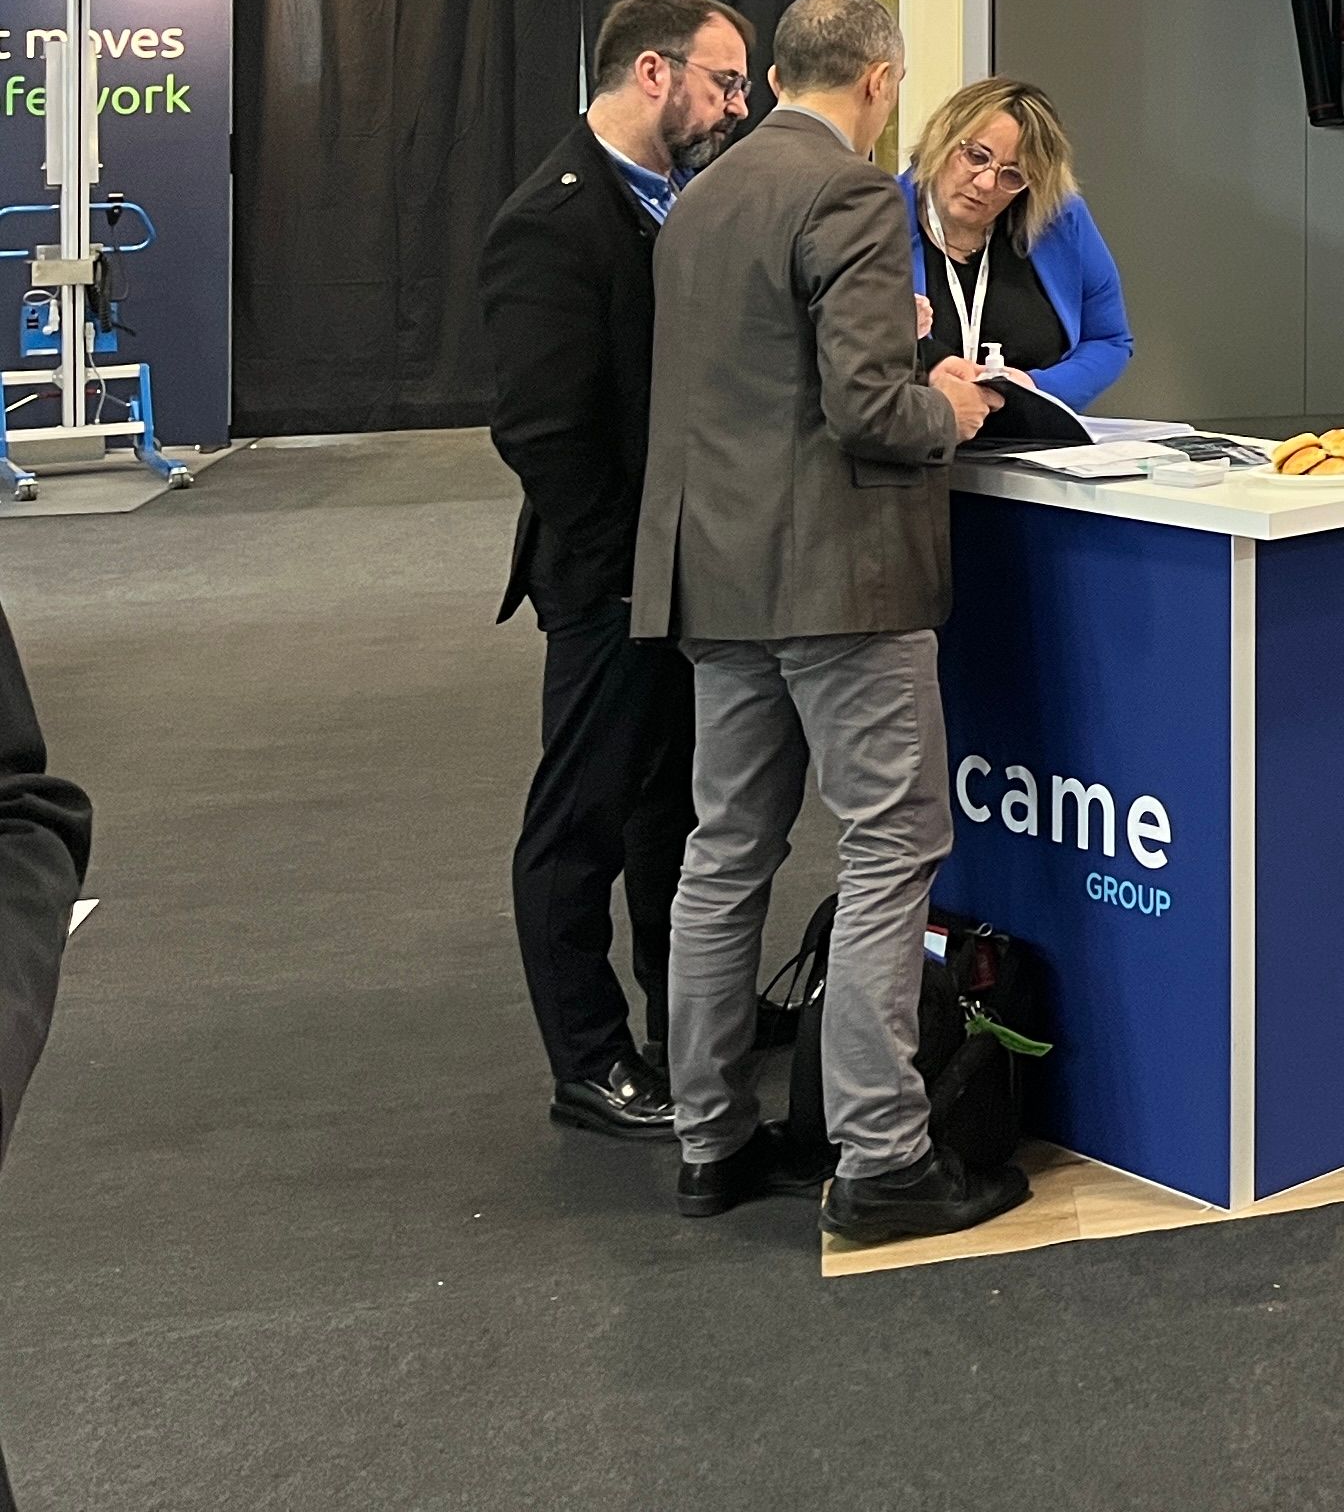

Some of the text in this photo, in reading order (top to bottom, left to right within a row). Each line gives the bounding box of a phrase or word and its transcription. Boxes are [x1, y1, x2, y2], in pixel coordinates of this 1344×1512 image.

[26, 28, 185, 59] mves
[956, 754, 1172, 870] came
[1086, 872, 1171, 917] GROUP
